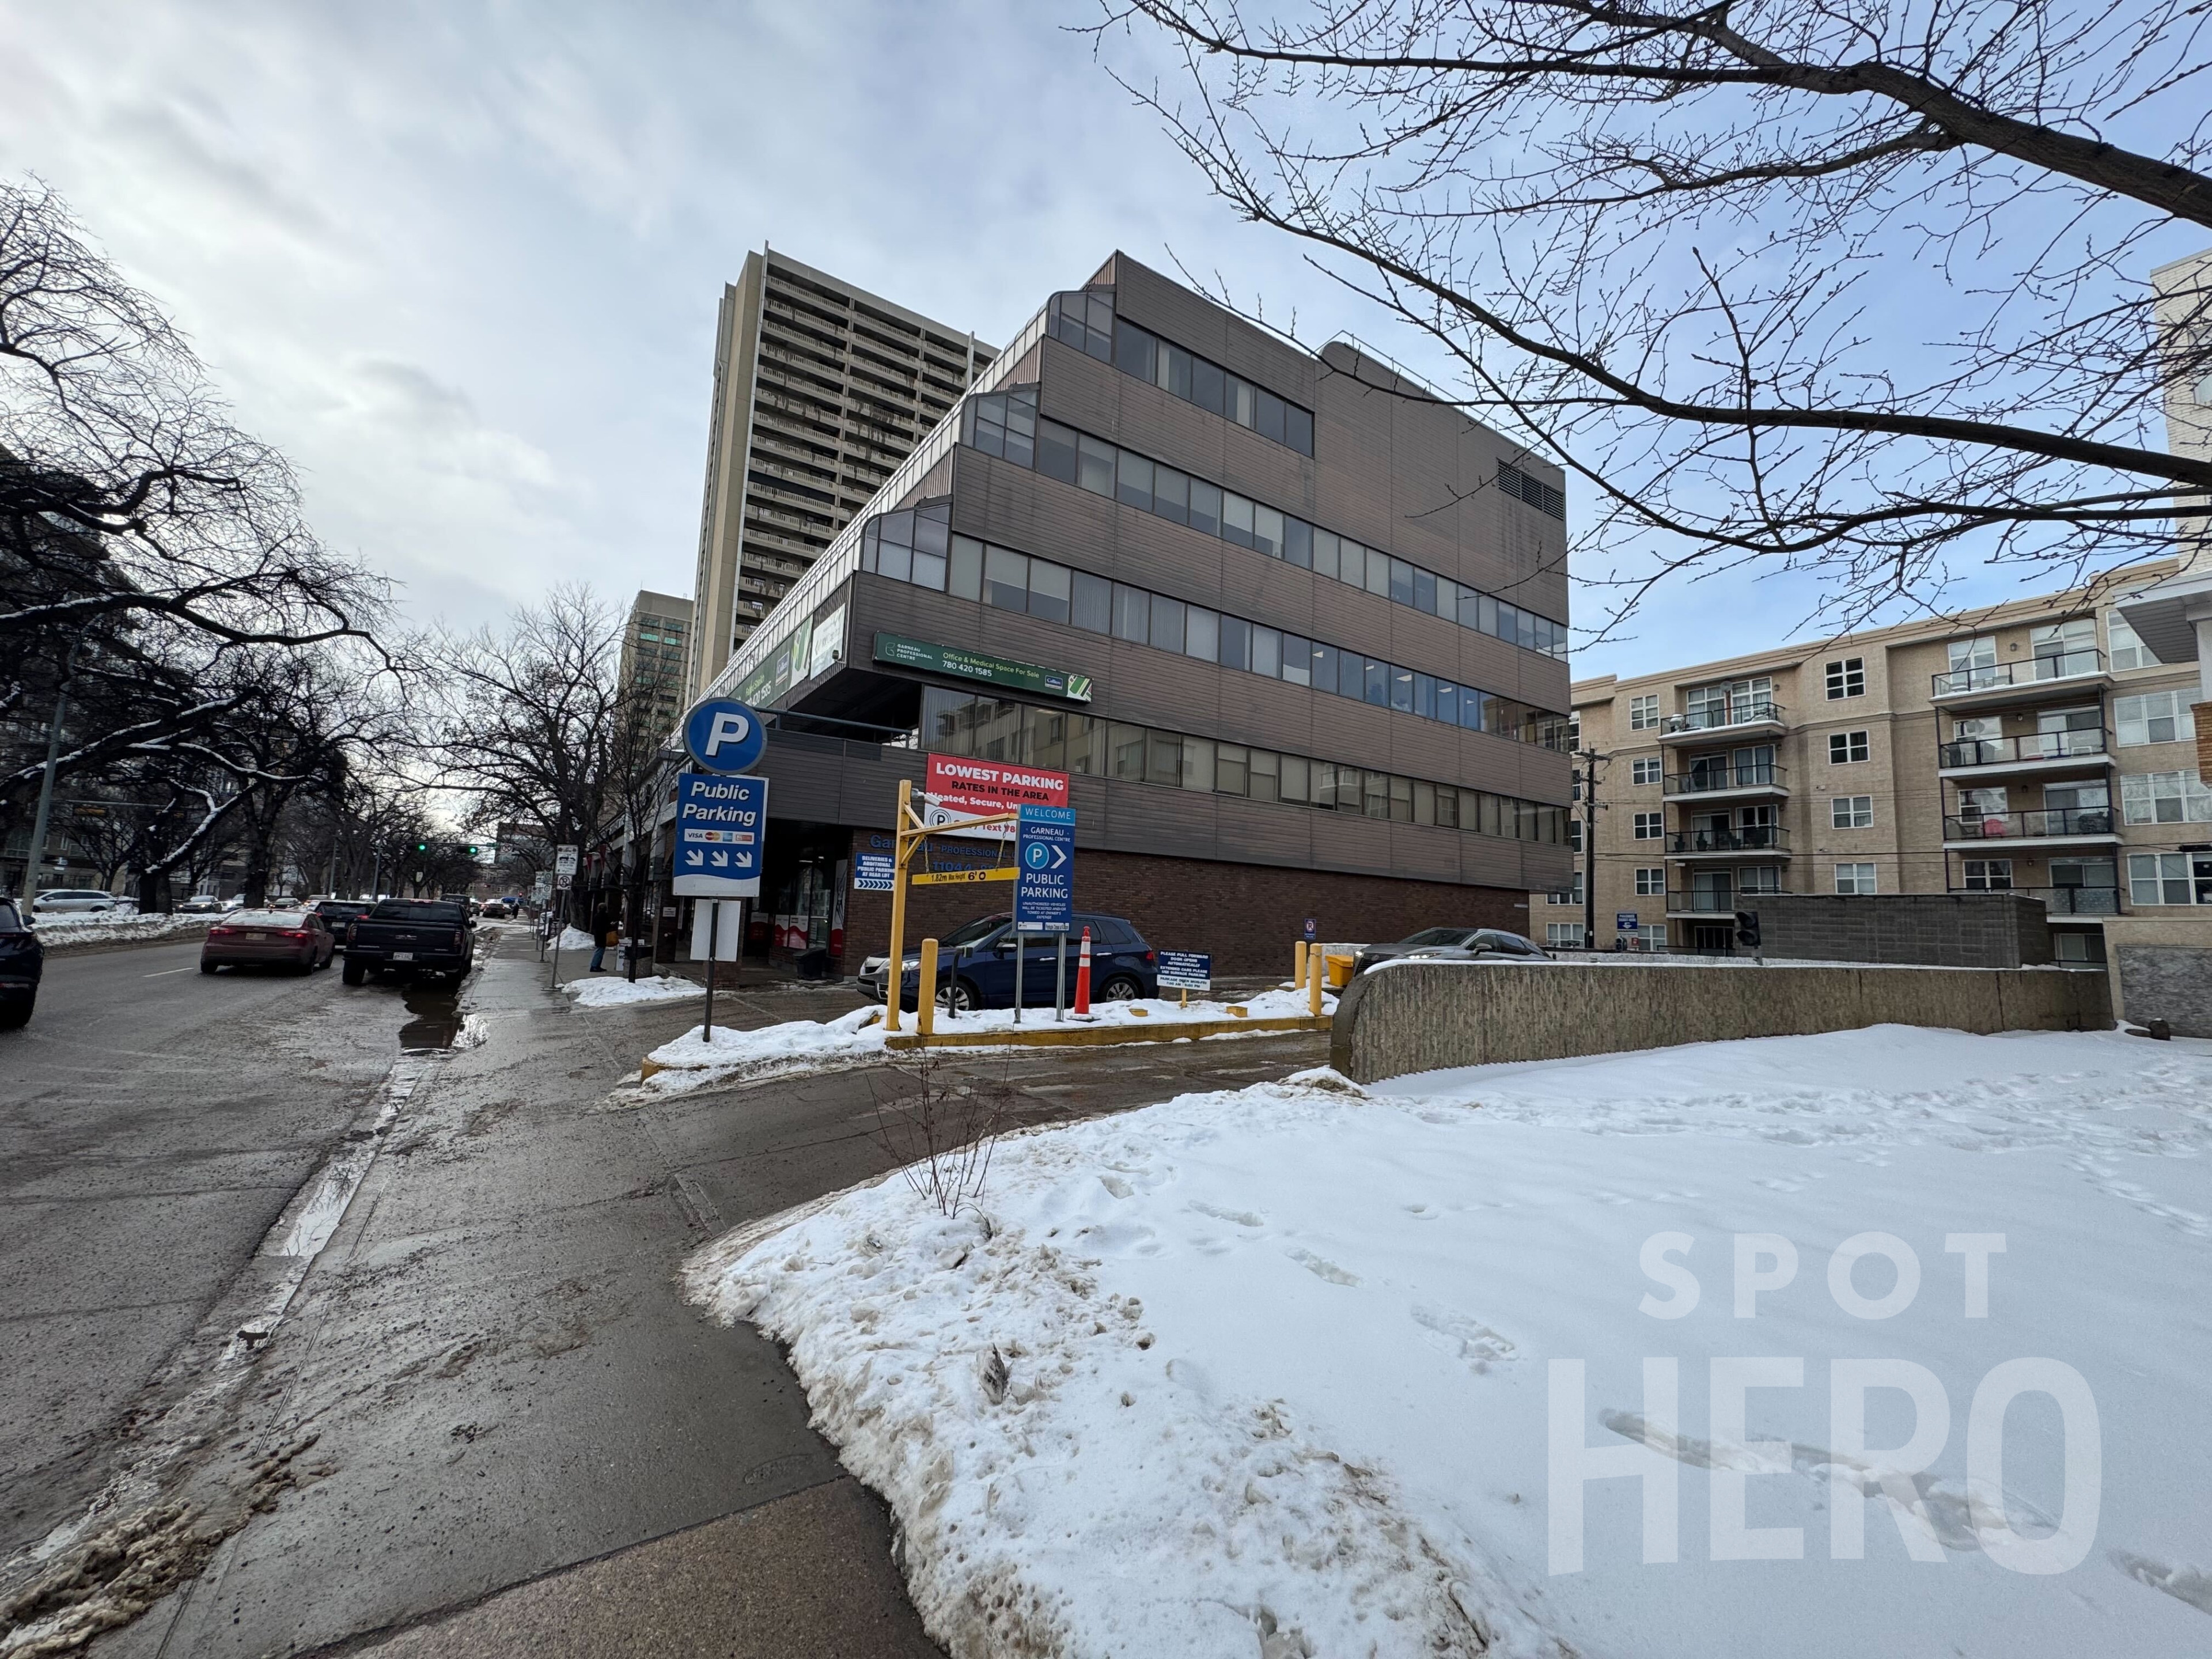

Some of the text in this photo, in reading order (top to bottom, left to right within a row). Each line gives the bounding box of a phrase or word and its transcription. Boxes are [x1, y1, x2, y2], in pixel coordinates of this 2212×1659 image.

[897, 643, 921, 652] GARNEAU
[897, 648, 933, 660] PROFESSIONAL
[942, 660, 993, 677] 780 420 1585
[943, 652, 963, 662] Office
[970, 657, 994, 668] Medical
[995, 664, 1014, 673] Space
[1027, 670, 1040, 678] Sale
[704, 712, 749, 757] P
[936, 762, 1064, 790] LOWEST PARKING
[691, 781, 749, 800] Public
[952, 781, 1049, 801] RATES IN THE AREA
[969, 797, 1004, 810] Secure,
[682, 803, 756, 827] Parking
[1025, 807, 1071, 820] WELCOME
[1031, 827, 1064, 836] GARNEAU
[941, 844, 1007, 859] PROFESSIONAL
[1033, 848, 1043, 863] P
[931, 873, 947, 882] 1.82m
[1026, 873, 1065, 885] PUBLIC
[1021, 887, 1068, 899] PARKING
